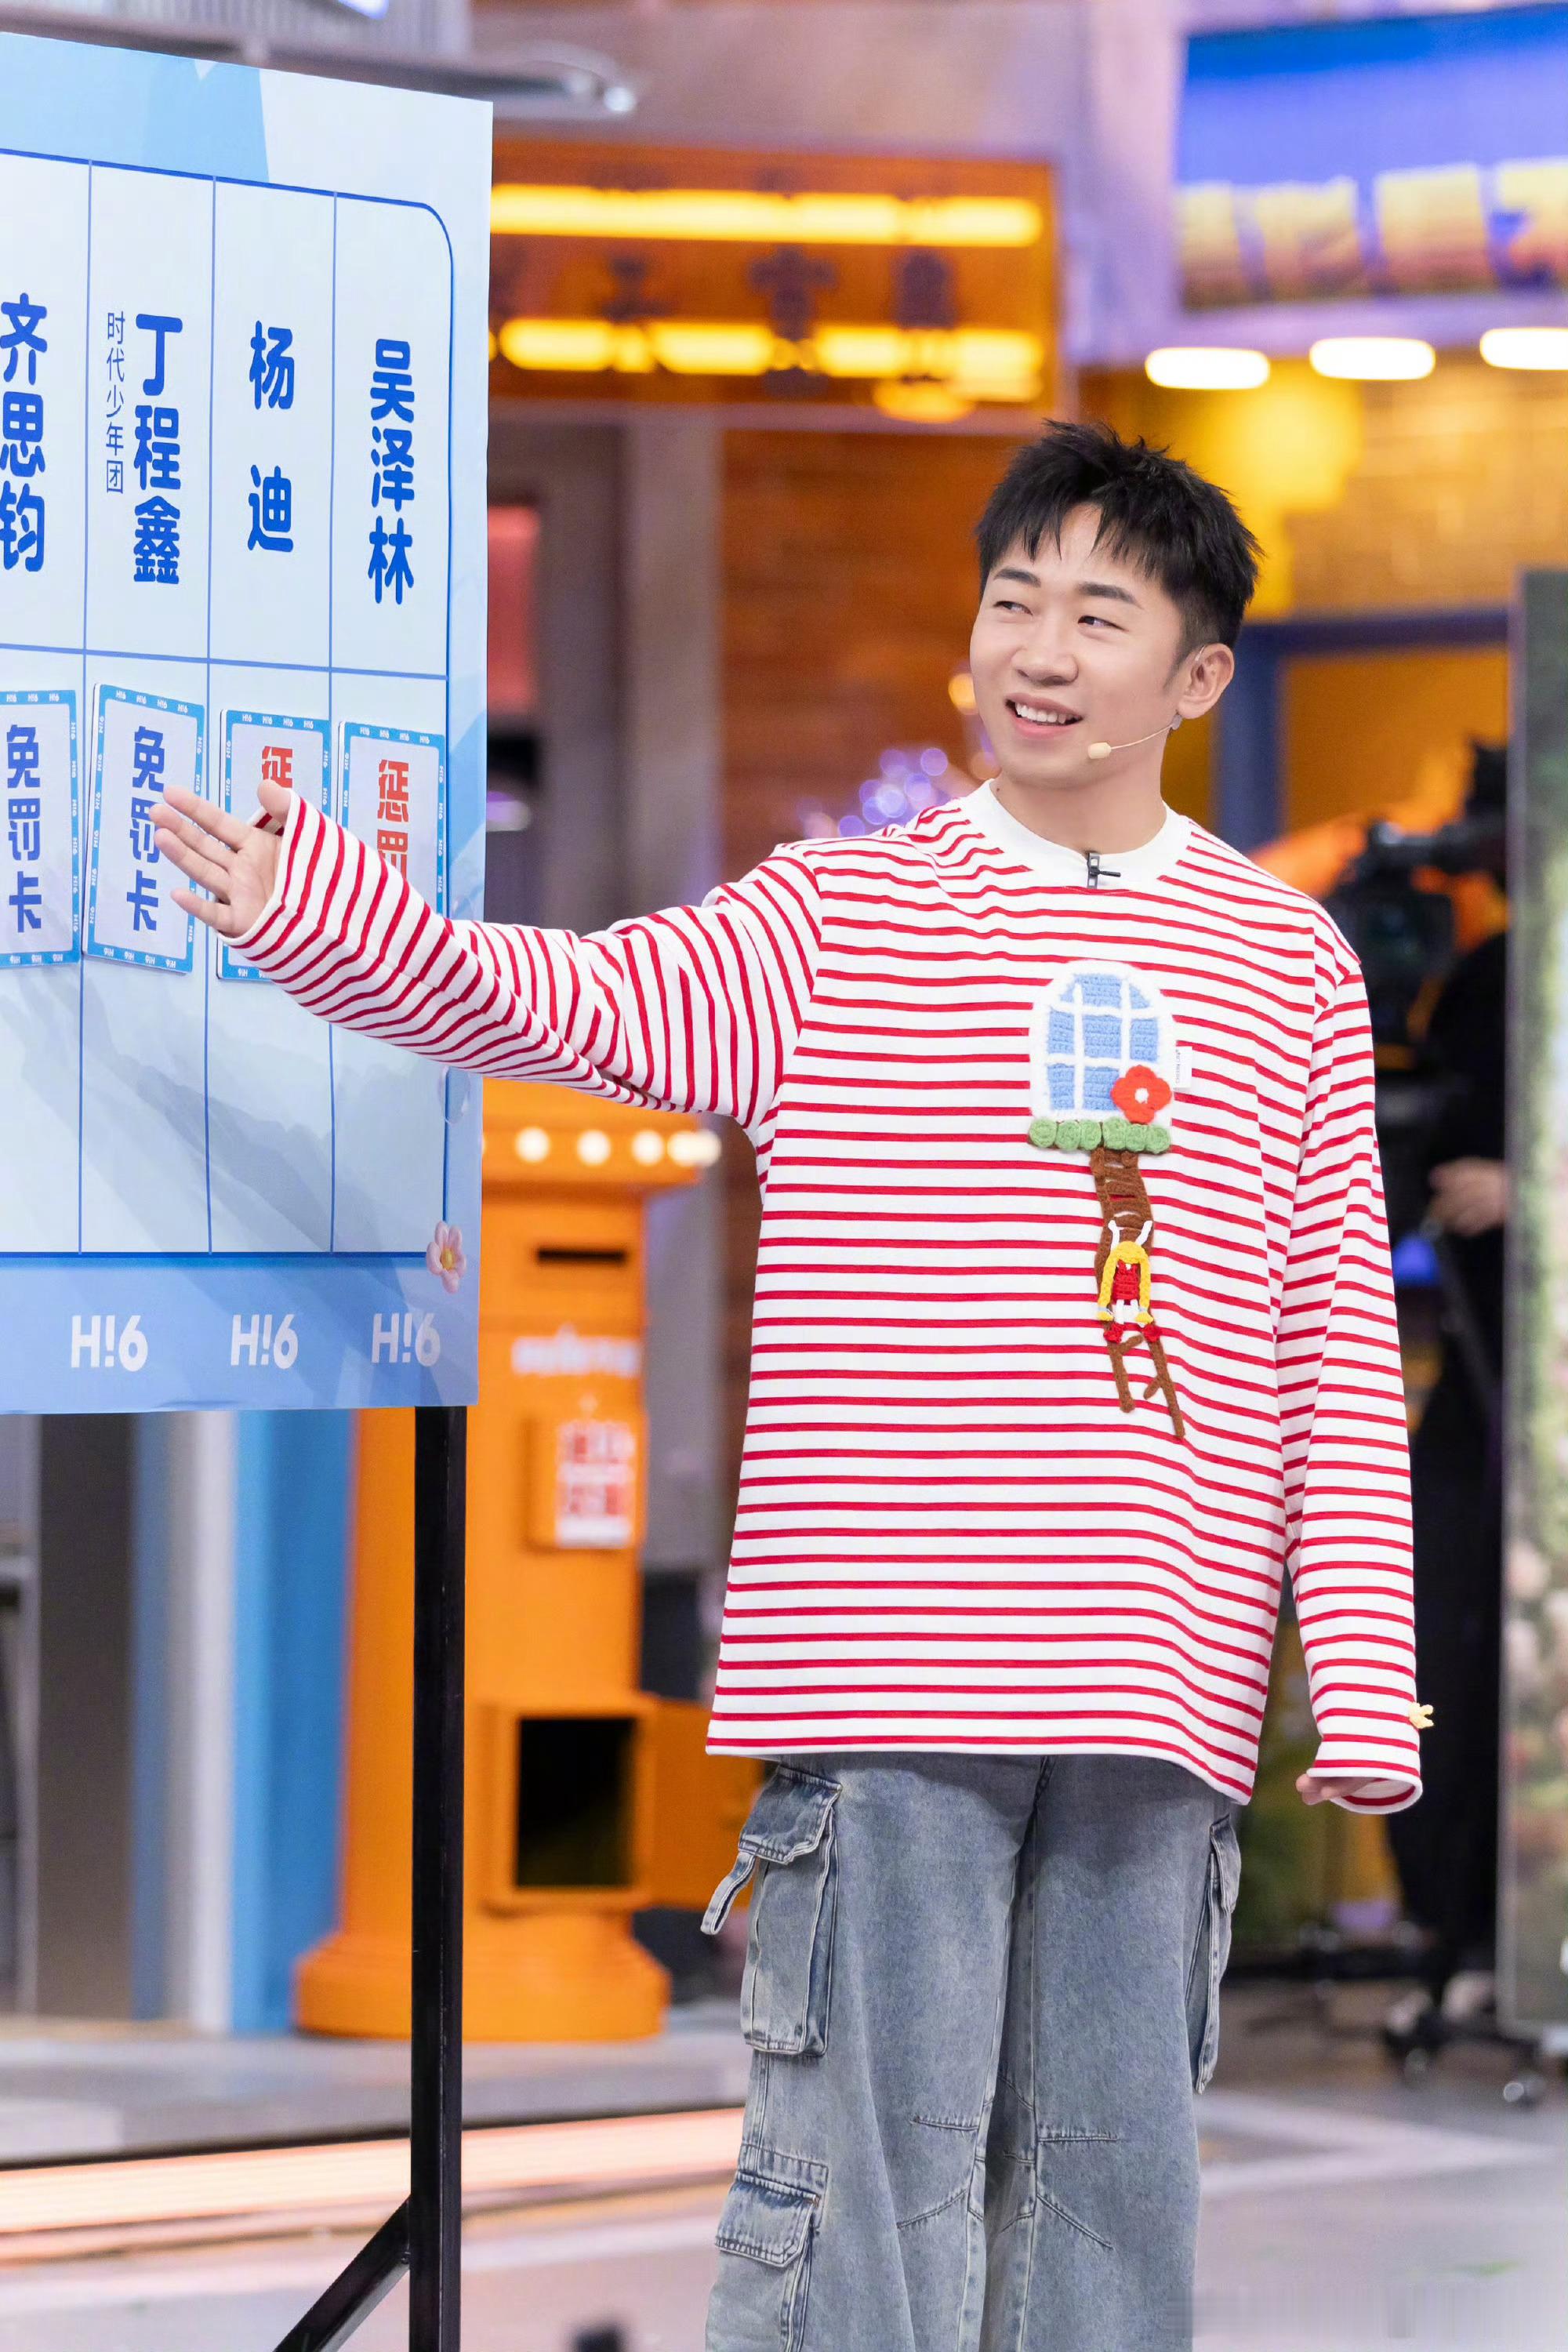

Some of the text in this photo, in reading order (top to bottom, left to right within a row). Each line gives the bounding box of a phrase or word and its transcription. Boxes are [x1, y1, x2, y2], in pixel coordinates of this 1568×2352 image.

[0, 293, 47, 572] 齐思钧
[106, 311, 125, 495] 时代少年团
[133, 313, 183, 585] 丁程鑫
[368, 339, 415, 605] 吴泽林
[6, 724, 42, 933] 免罚卡
[126, 726, 165, 931] 免罚卡
[71, 1312, 441, 1372] H!6 H!6 H!6
